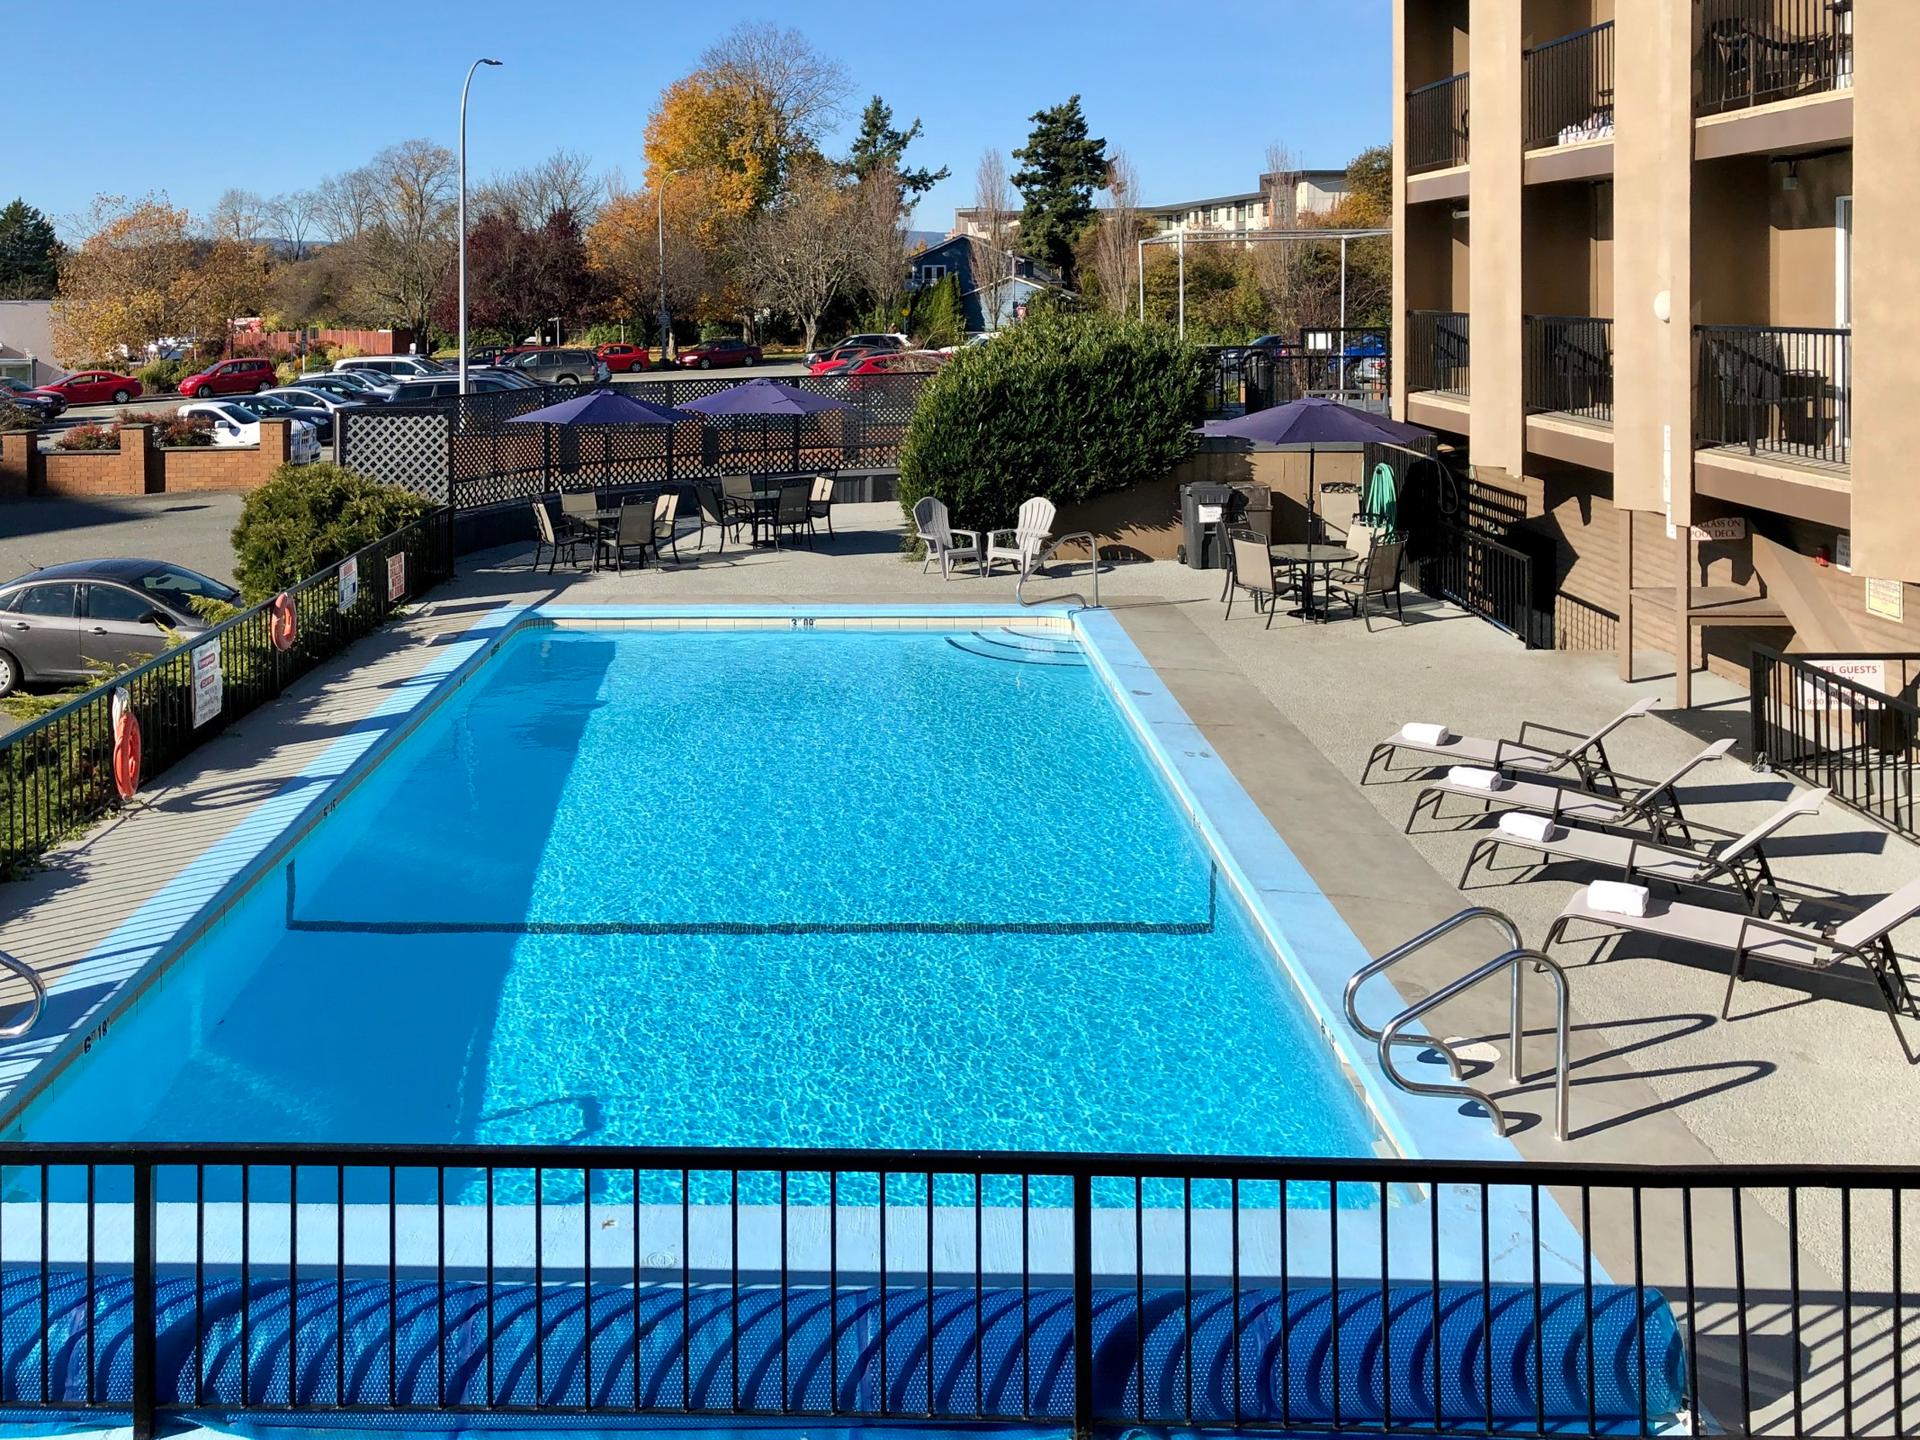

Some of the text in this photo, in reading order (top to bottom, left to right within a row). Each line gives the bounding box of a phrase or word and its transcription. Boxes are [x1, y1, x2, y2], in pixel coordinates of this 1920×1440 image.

[1728, 519, 1741, 528] ON
[1715, 530, 1736, 538] DECK
[1840, 665, 1877, 674] GUESTS
